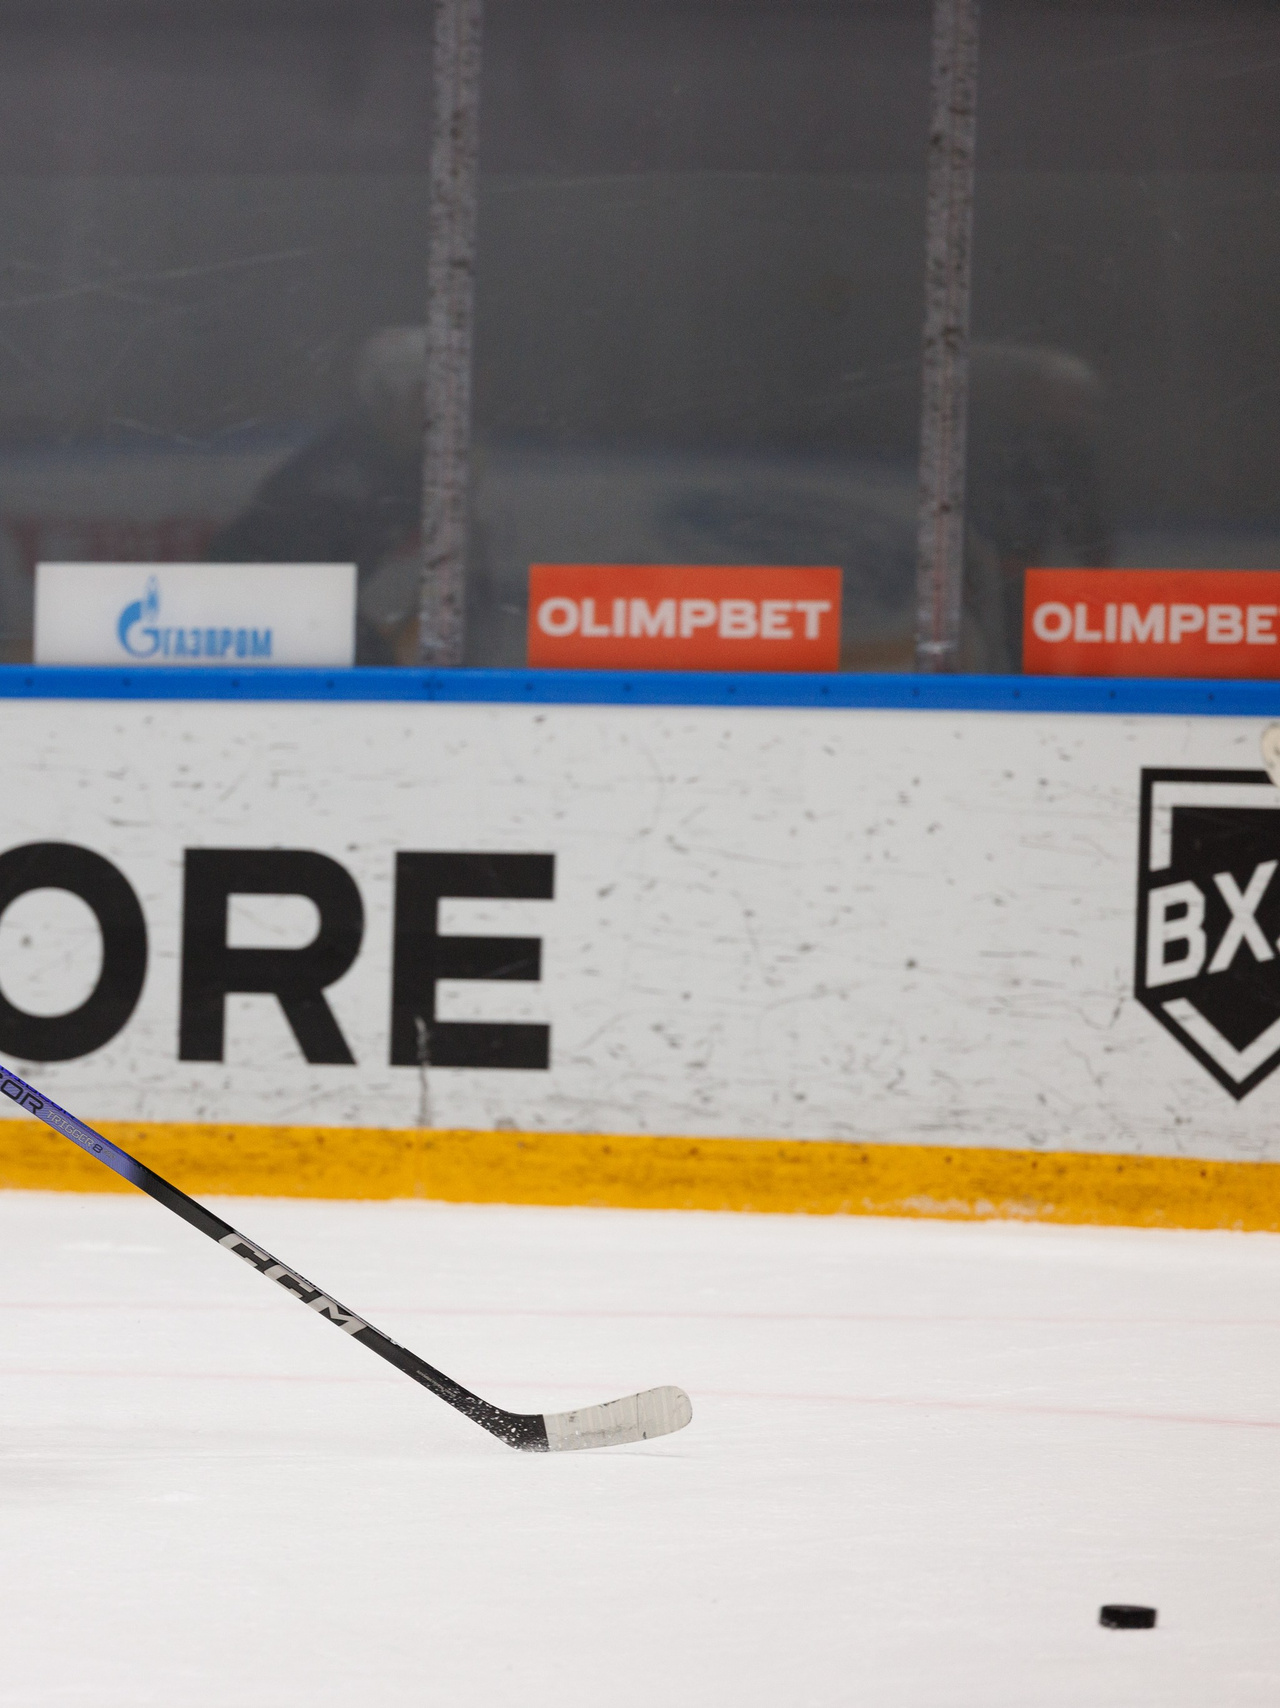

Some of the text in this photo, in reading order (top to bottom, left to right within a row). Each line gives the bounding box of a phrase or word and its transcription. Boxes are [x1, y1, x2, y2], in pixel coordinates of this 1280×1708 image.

[537, 597, 831, 640] OLIMPBET
[1033, 602, 1280, 645] OLIMPBE
[46, 1109, 95, 1148] TRIGGER
[92, 1143, 103, 1154] 8
[218, 1232, 368, 1336] CCM
